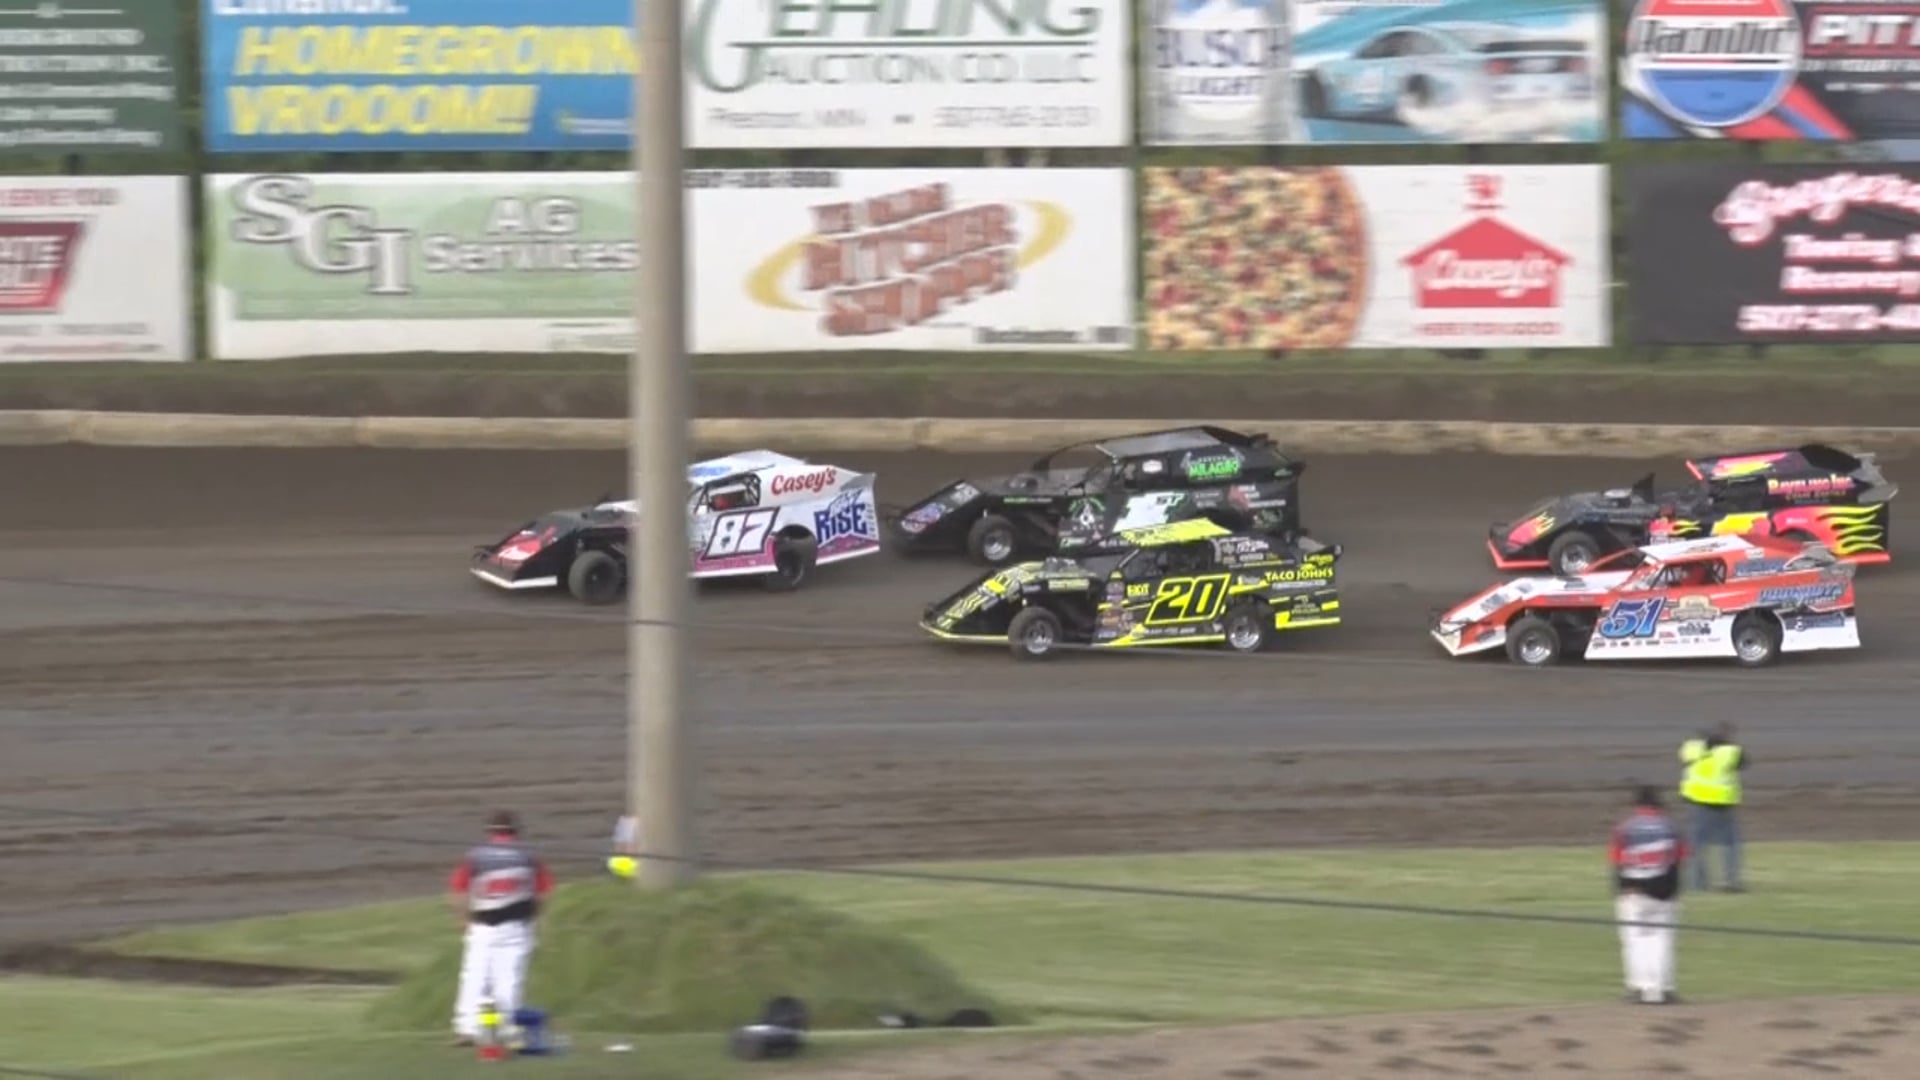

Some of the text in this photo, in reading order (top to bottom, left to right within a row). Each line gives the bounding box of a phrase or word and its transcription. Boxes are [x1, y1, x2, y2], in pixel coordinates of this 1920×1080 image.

[233, 26, 638, 75] HOMEGROWN
[483, 196, 580, 236] AG
[423, 234, 638, 273] Services
[771, 467, 837, 496] Casey's
[700, 508, 781, 560] 87
[813, 503, 868, 547] RISE
[1265, 571, 1295, 581] TACO
[1144, 573, 1231, 625] 20
[1600, 597, 1667, 638] 51
